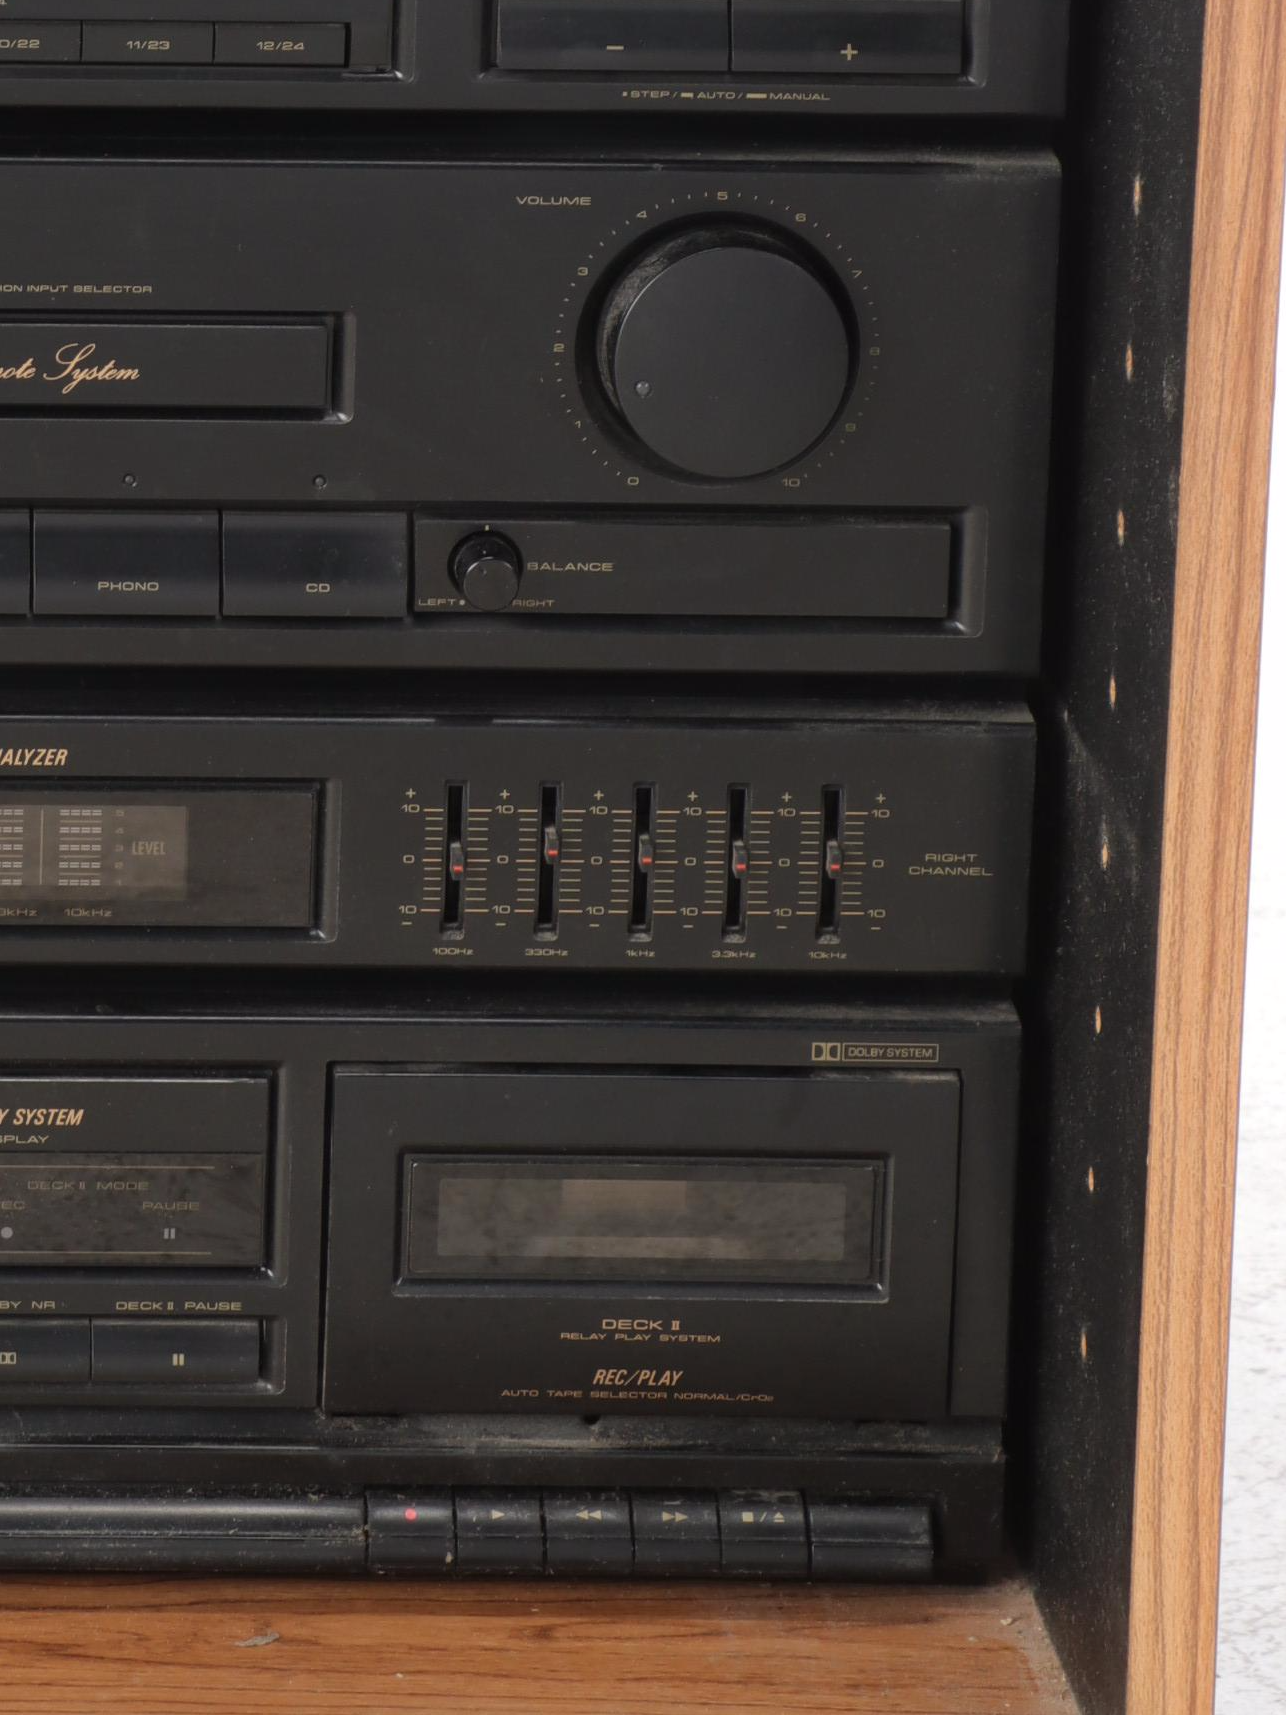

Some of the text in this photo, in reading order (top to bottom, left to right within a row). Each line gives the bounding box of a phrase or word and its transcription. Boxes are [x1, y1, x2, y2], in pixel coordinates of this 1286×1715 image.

[515, 195, 592, 206] VOLUME
[26, 284, 69, 293] INPUT
[42, 342, 141, 396] System
[527, 561, 614, 572] BALANCE
[97, 581, 160, 592] PHONO
[305, 582, 331, 593] CD
[924, 853, 978, 863] RIGHT
[908, 866, 993, 876] CHANNEL
[847, 1047, 933, 1058] DOLBY SYSTEM
[12, 1108, 85, 1126] SYSTEM
[31, 1300, 56, 1310] NR
[115, 1301, 242, 1311] DECK PAUSE
[601, 1318, 663, 1331] DECK
[560, 1332, 721, 1343] RELAY PLAY SYSTEM
[592, 1368, 684, 1386] REC/PLAY
[500, 1389, 583, 1398] AUTO TAPE
